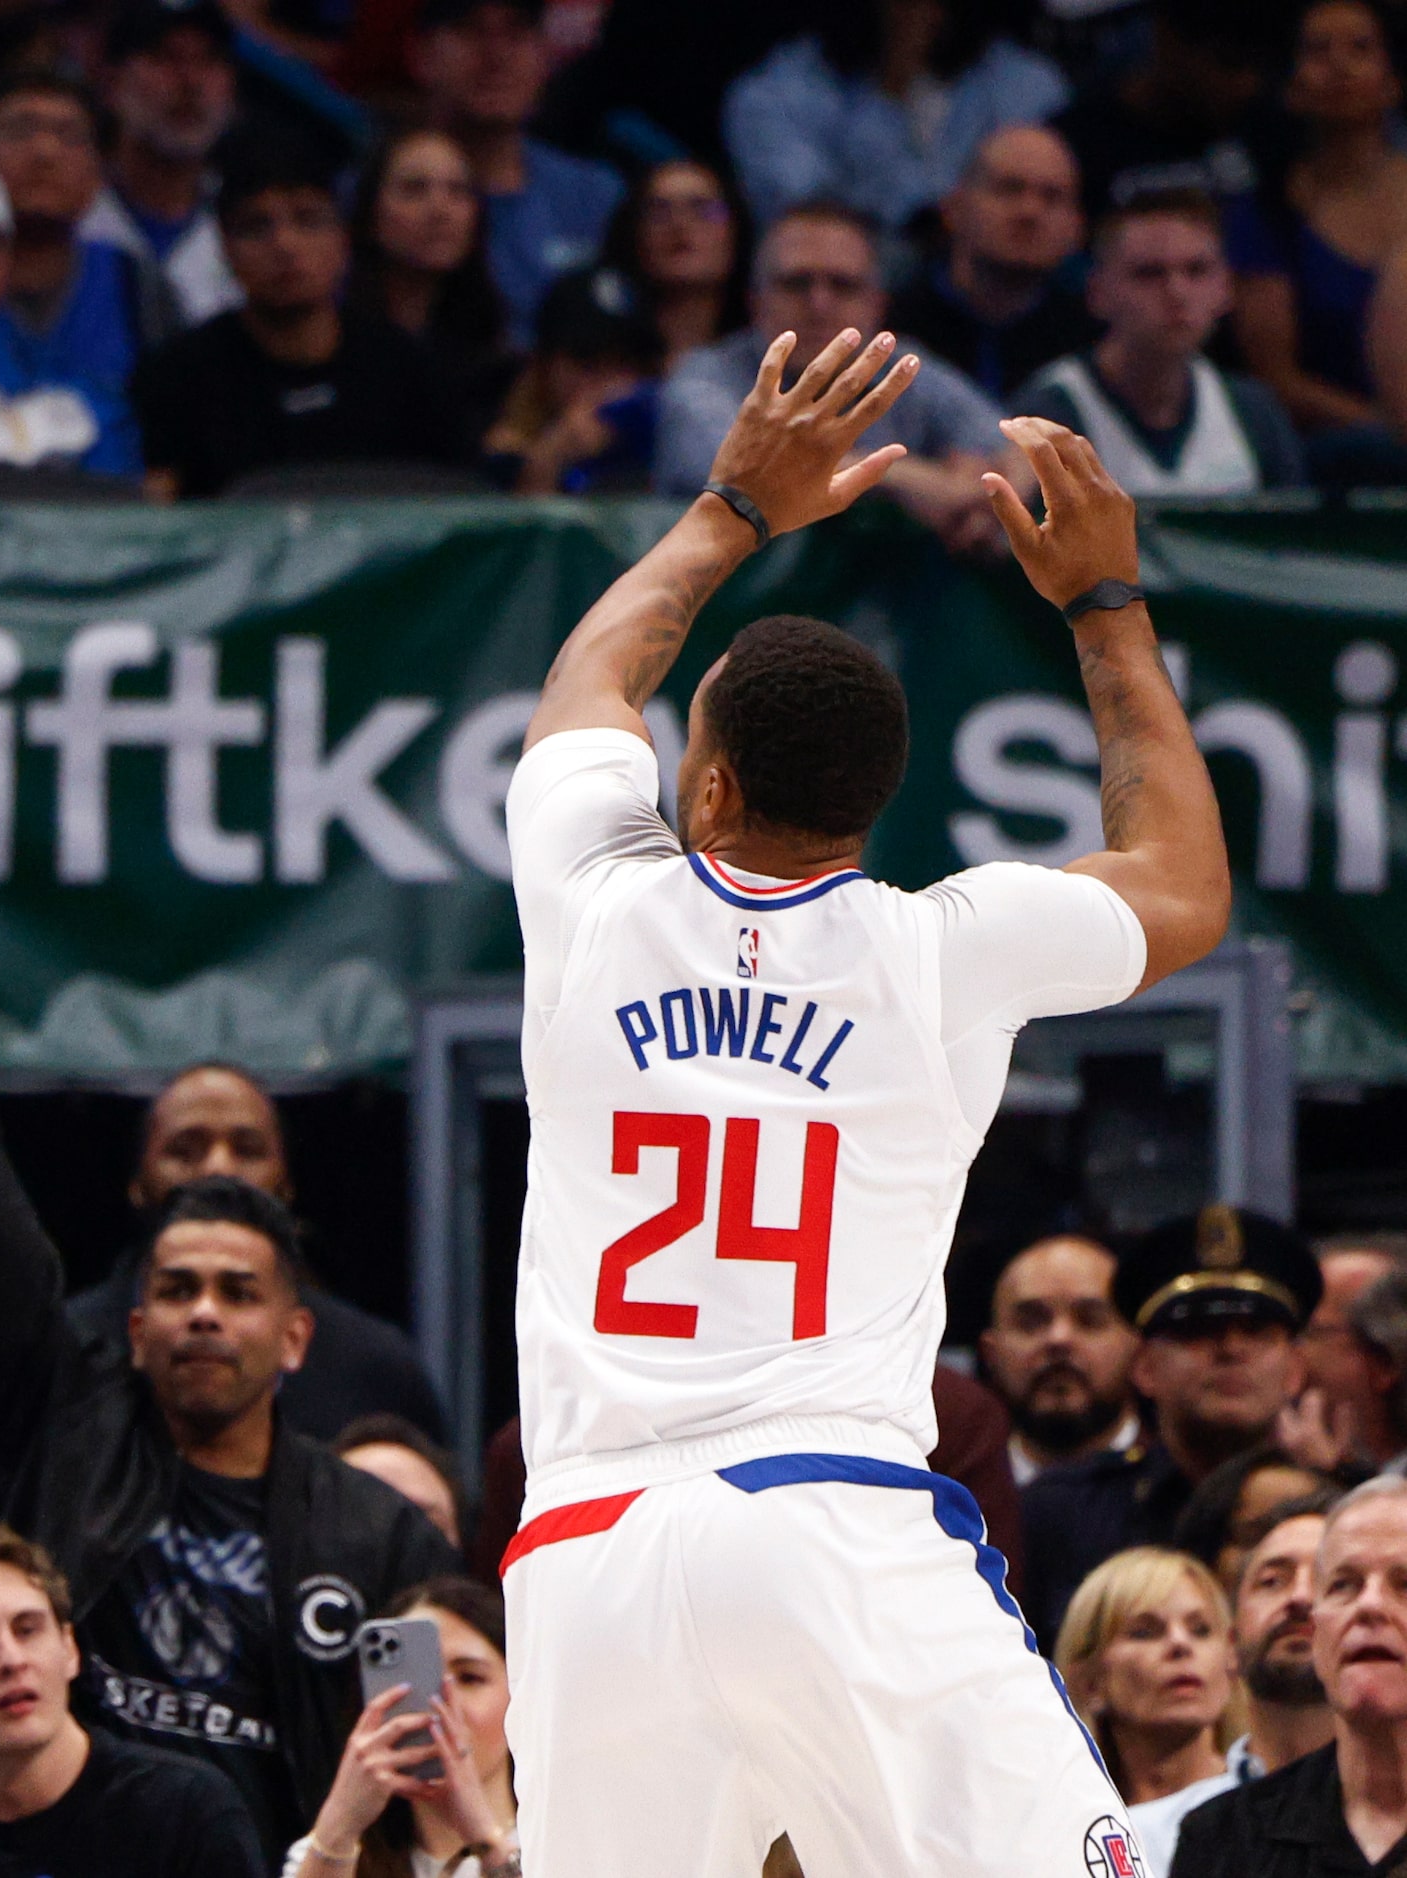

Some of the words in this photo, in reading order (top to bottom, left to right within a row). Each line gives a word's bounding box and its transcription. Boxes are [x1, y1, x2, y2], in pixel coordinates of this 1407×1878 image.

[945, 641, 1407, 893] shi
[615, 987, 854, 1091] POWELL
[594, 1111, 839, 1341] 24
[300, 1588, 350, 1646] C
